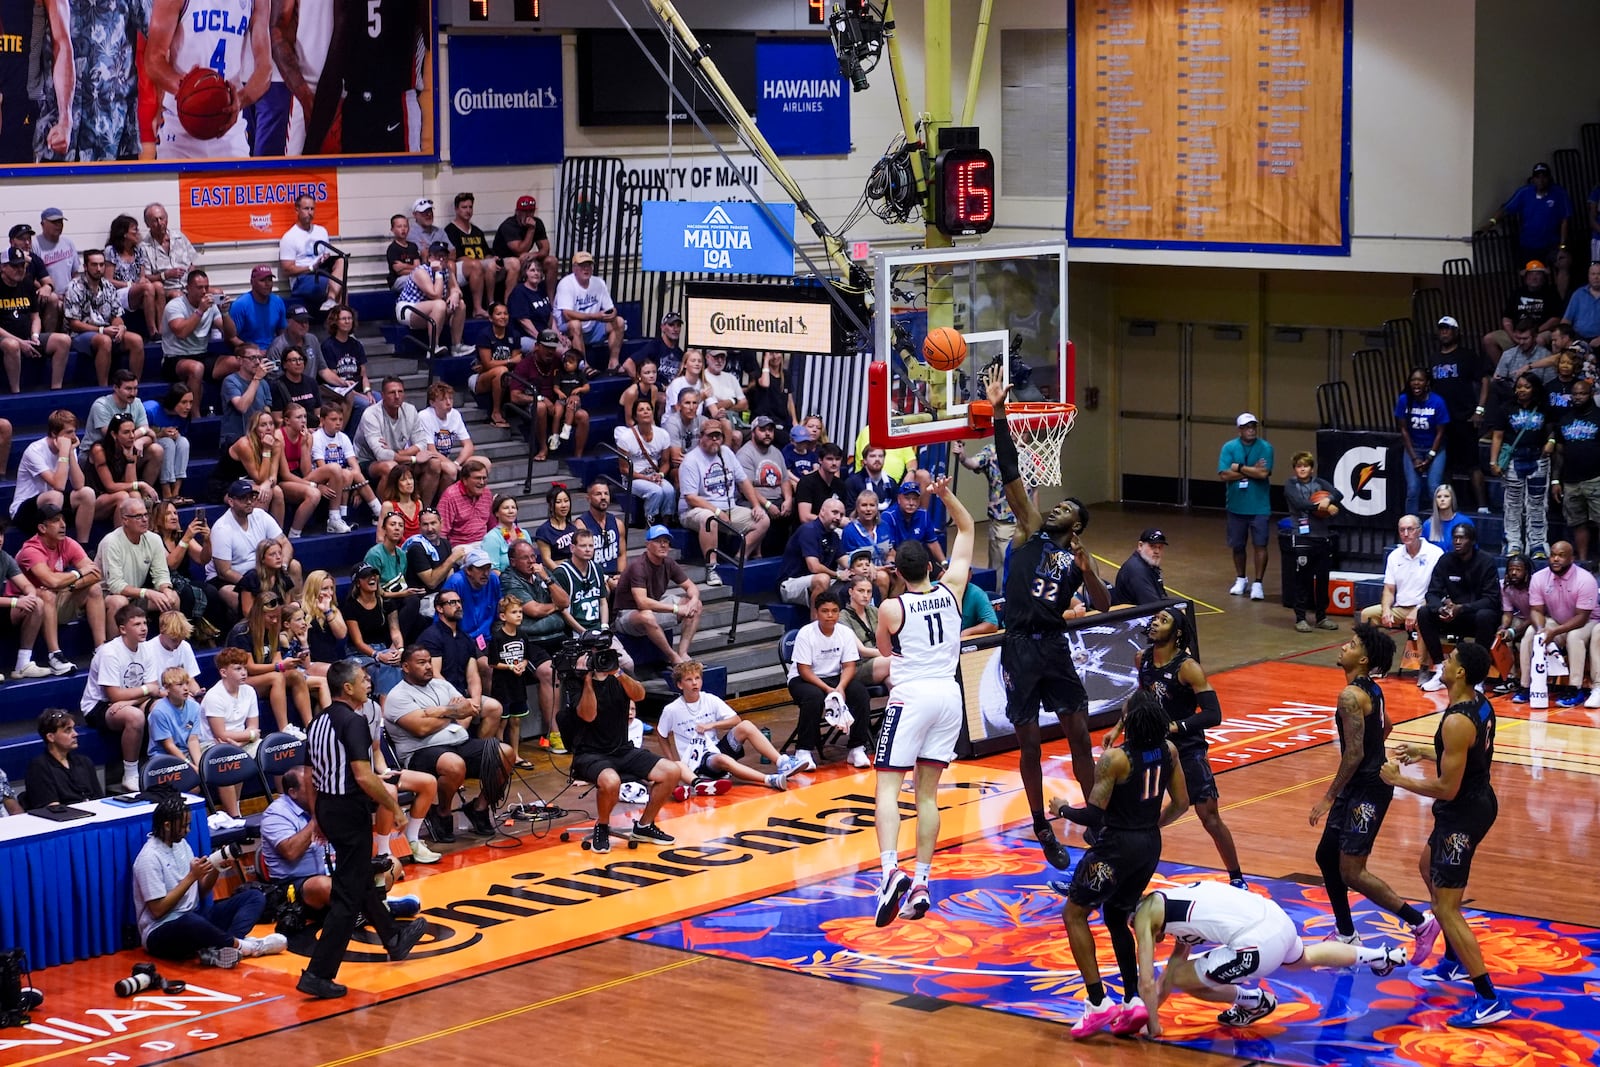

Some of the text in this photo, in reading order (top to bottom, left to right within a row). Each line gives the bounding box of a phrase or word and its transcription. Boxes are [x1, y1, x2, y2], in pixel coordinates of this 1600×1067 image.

[193, 10, 248, 36] UCLA
[368, 0, 382, 38] 5
[210, 38, 226, 79] 4
[764, 80, 840, 98] HAWAIIAN
[454, 88, 544, 115] Continental
[782, 102, 823, 112] AIRLINES
[691, 167, 712, 188] OF
[716, 166, 758, 187] MAUI
[190, 186, 232, 208] EAST
[959, 162, 988, 220] 15
[684, 230, 752, 250] MAUNA
[704, 250, 732, 268] LOA
[710, 312, 793, 334] Continental
[1410, 416, 1430, 430] 25
[1334, 446, 1387, 516] G
[594, 529, 617, 548] BLED
[594, 542, 618, 563] BLUE
[1032, 578, 1059, 602] 32
[910, 596, 952, 614] KARABAN
[924, 612, 944, 646] 11
[877, 707, 896, 762] HUSKIES
[274, 749, 296, 761] LIVE
[158, 772, 182, 784] LIVE
[218, 761, 240, 773] LIVE
[1141, 765, 1161, 800] 11
